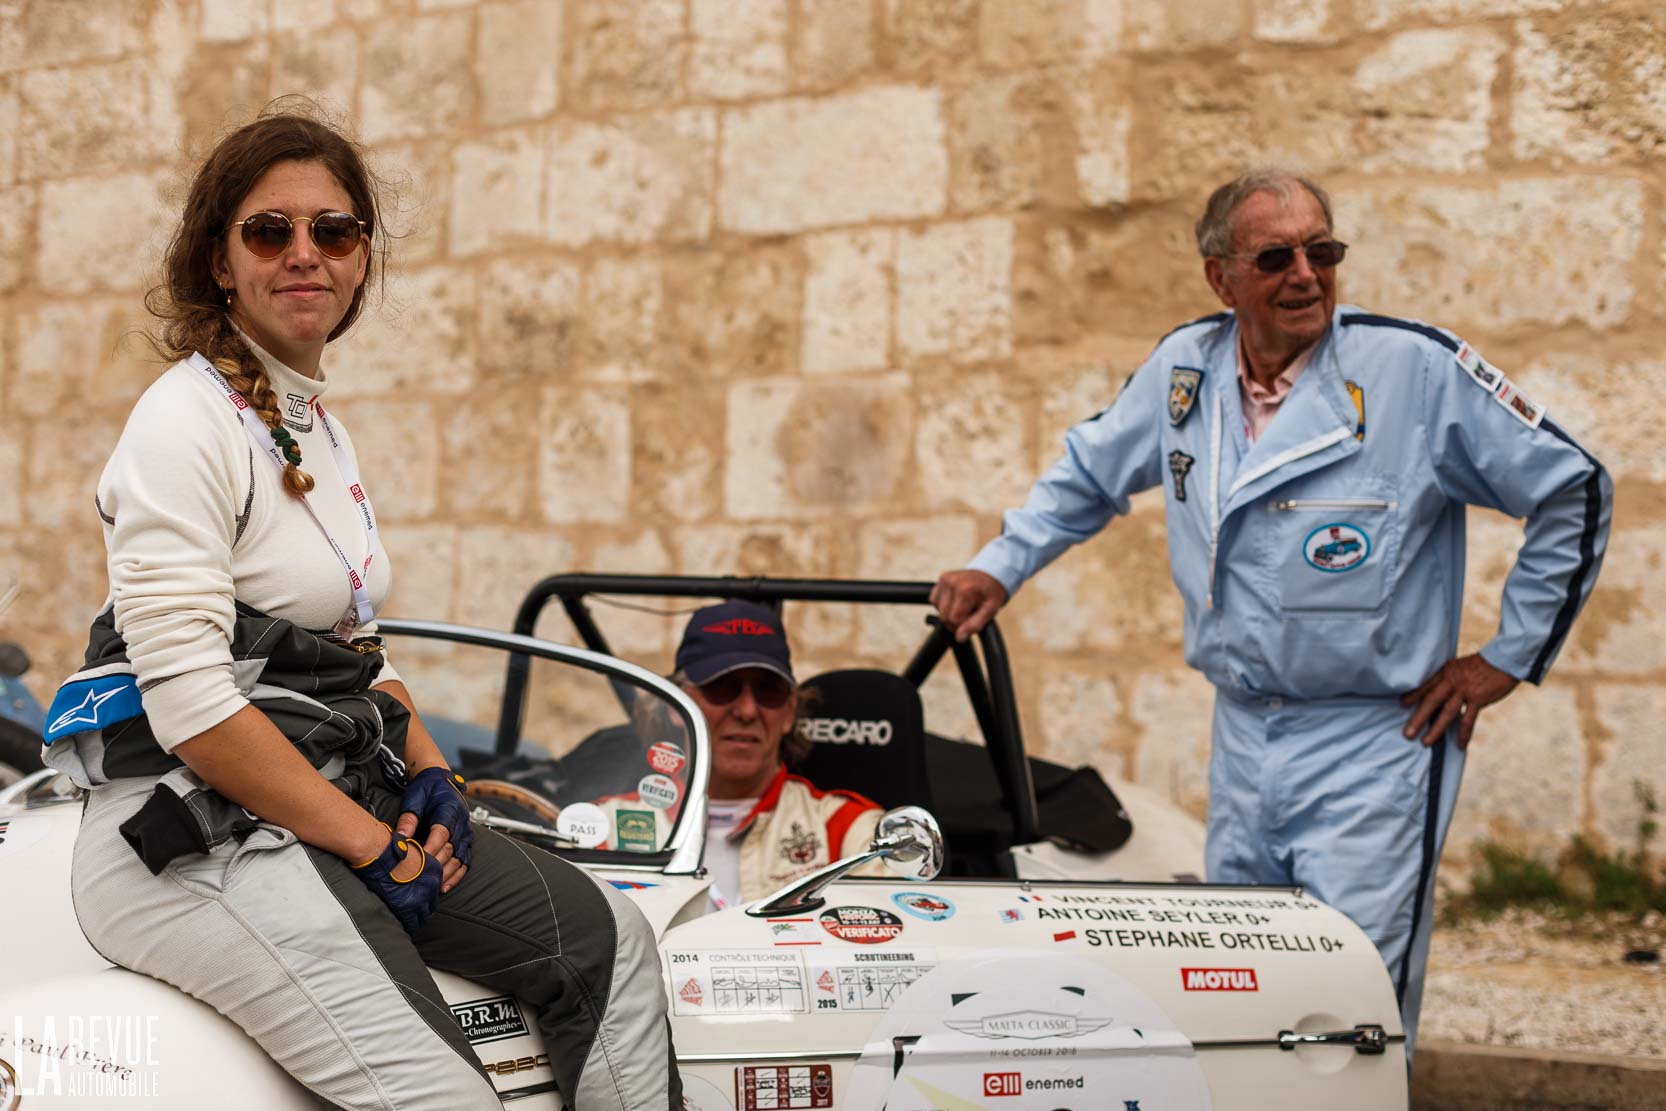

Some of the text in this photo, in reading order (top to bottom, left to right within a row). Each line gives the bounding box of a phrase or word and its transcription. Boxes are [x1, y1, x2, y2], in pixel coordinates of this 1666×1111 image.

[205, 367, 233, 393] enemed
[798, 718, 893, 745] RECARO
[570, 824, 597, 835] PASS
[1038, 907, 1145, 922] ANTOINE
[1148, 909, 1244, 925] SEYLER
[837, 927, 901, 938] VERIFICATO
[1085, 929, 1216, 949] STEPHANE
[1219, 932, 1317, 952] ORTELLI
[672, 954, 699, 963] 2014
[752, 953, 797, 962] TECHNIQUE
[854, 953, 915, 962] SCRUTINEERING
[1187, 971, 1257, 989] MOTUL
[818, 999, 838, 1009] 2015
[988, 1020, 1072, 1031] MALTA CLASSIC
[1025, 1075, 1084, 1090] enemed
